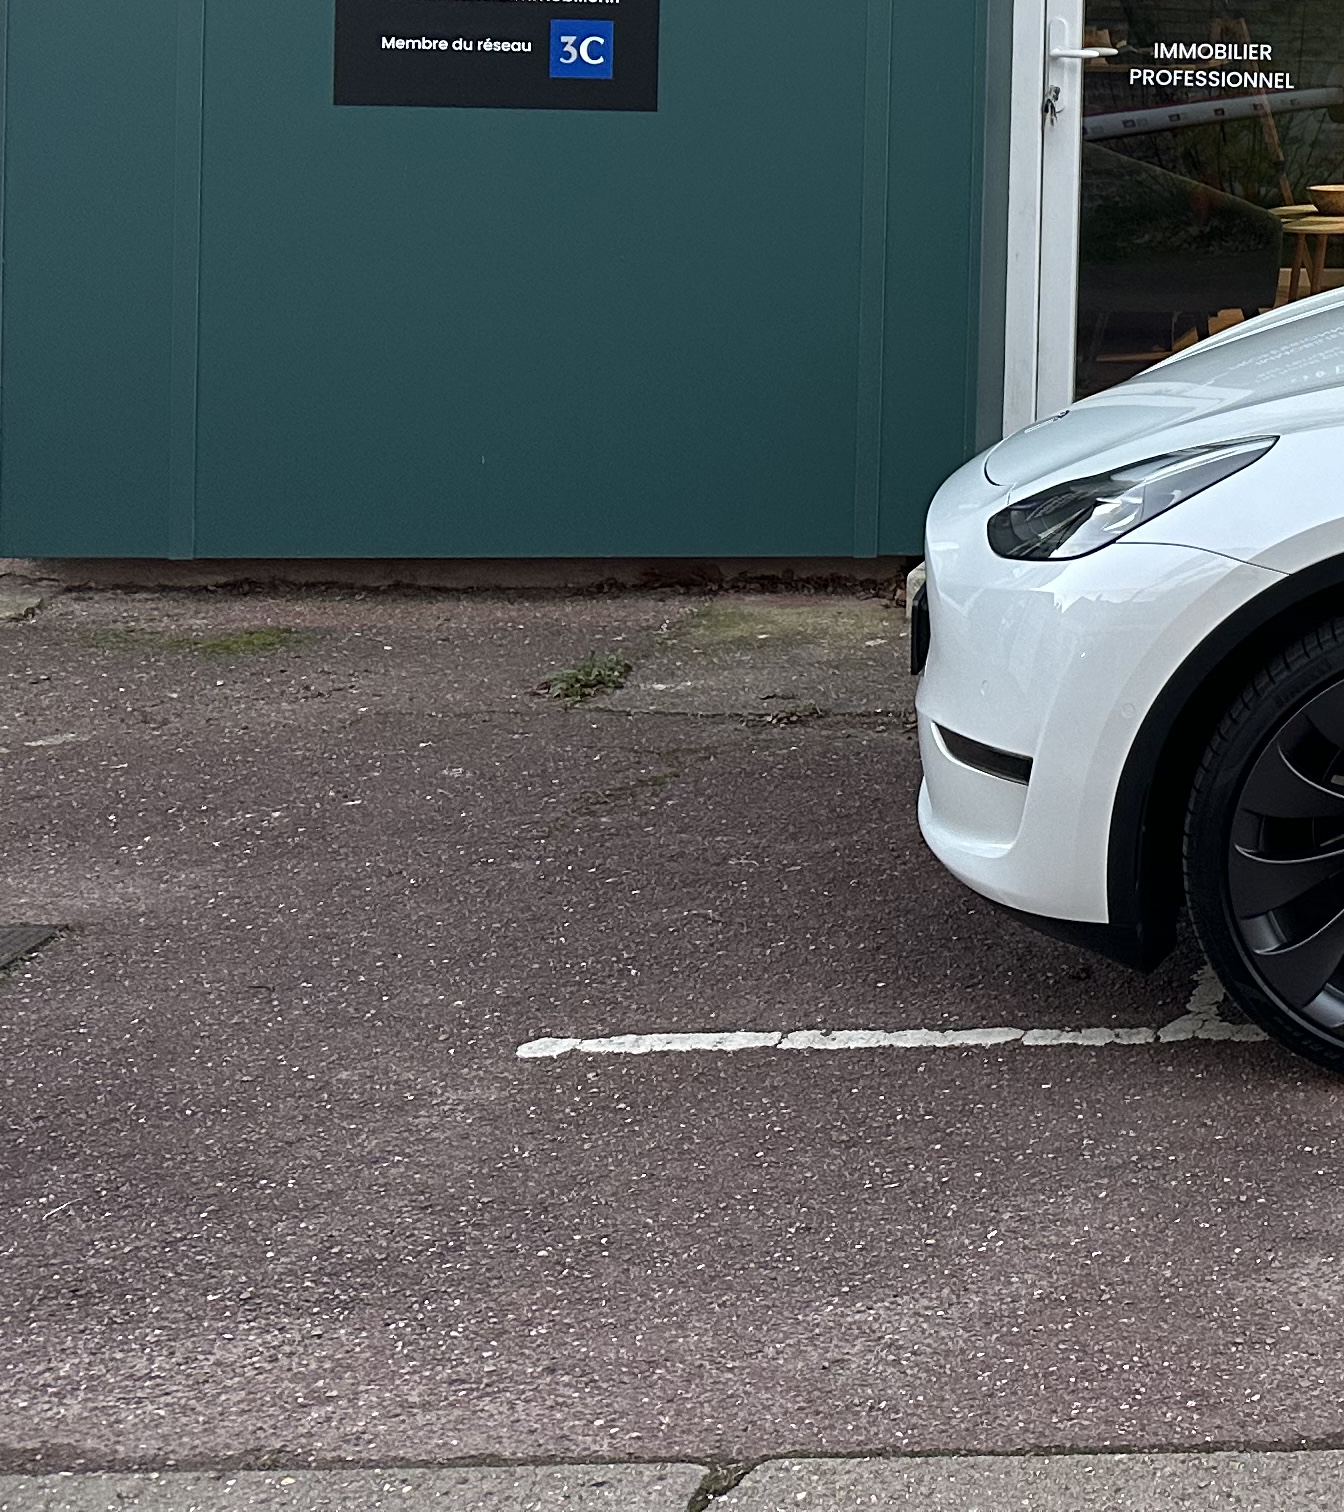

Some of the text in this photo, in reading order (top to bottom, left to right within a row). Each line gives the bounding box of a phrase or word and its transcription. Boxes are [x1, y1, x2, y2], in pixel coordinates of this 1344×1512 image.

[382, 37, 531, 52] Membre du réseau
[559, 35, 604, 66] 3C
[1154, 43, 1271, 60] IMMOBILIER
[1130, 69, 1294, 88] PROFESSIONNEL
